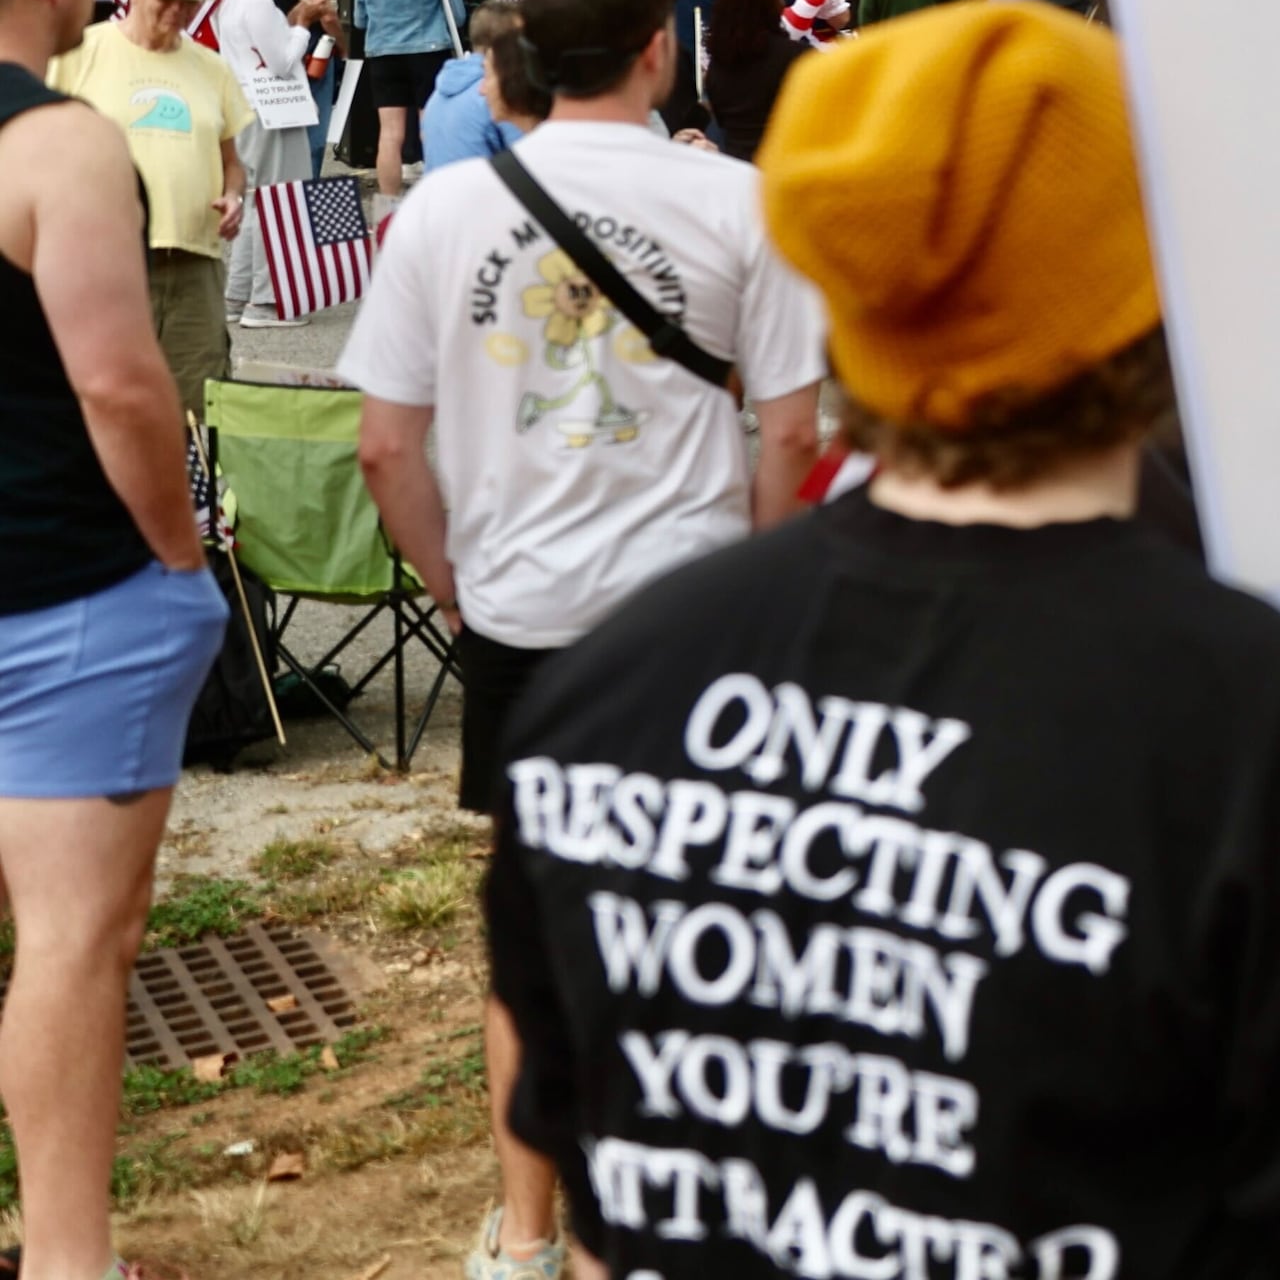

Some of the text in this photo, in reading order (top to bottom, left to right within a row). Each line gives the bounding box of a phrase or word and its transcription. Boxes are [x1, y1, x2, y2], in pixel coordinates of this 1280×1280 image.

[271, 84, 304, 94] TRUMP
[471, 210, 687, 326] SUCK M POSITIVIT
[682, 671, 971, 812] ONLY
[508, 754, 1130, 974] RESPECTING
[588, 889, 990, 1062] WOMEN
[618, 1028, 980, 1179] YOU'RE
